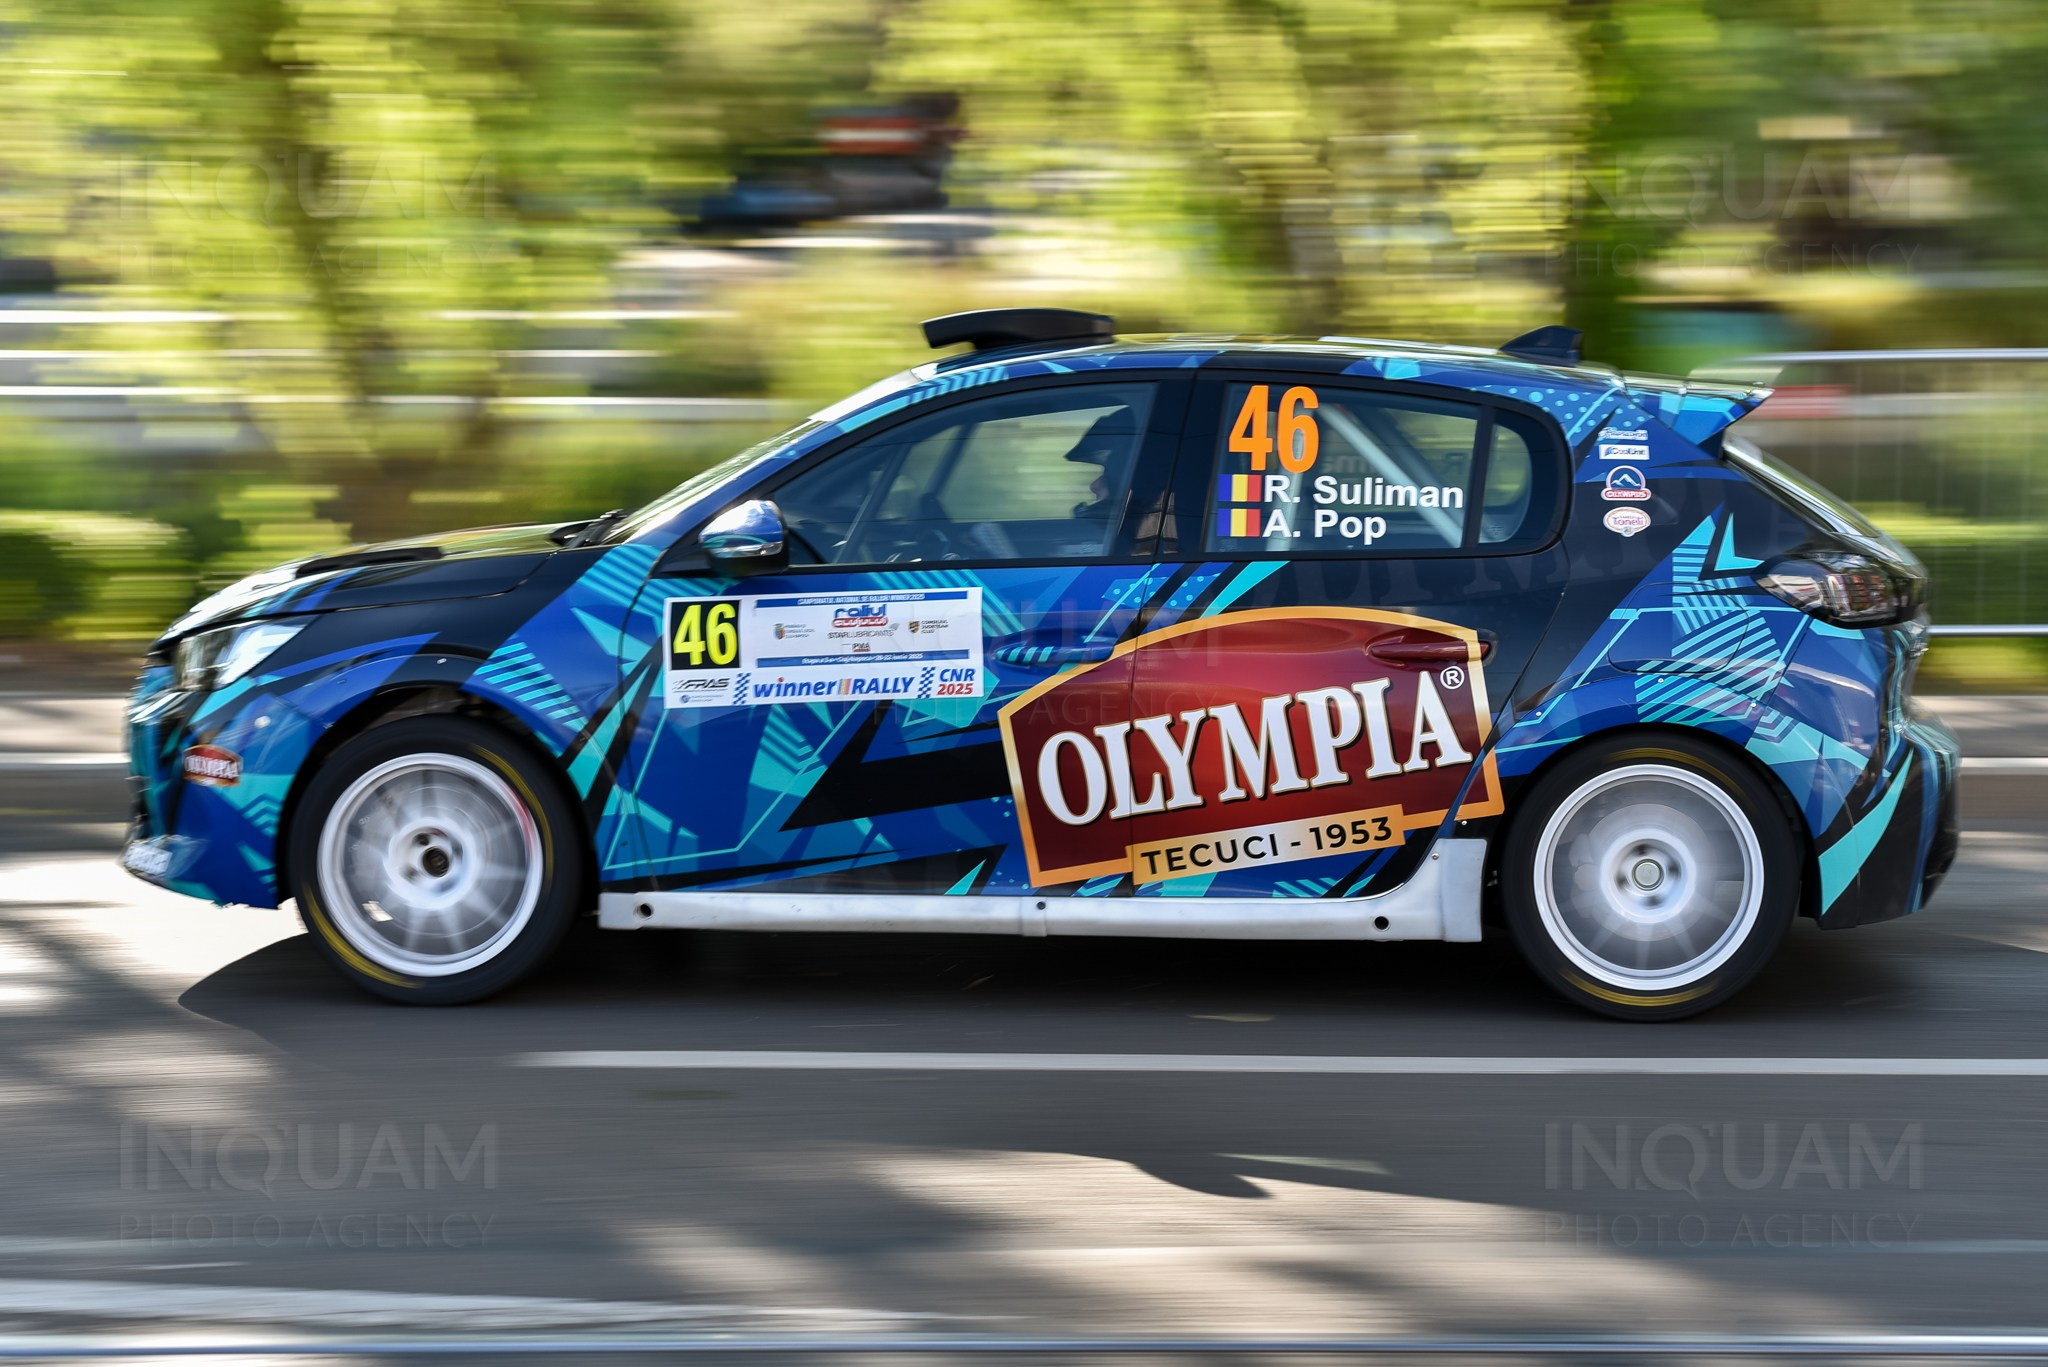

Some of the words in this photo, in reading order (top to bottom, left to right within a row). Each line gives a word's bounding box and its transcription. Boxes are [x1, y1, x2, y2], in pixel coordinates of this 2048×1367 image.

[1228, 385, 1319, 473] 46
[1264, 475, 1300, 504] R.
[1313, 475, 1464, 508] Suliman
[1262, 510, 1300, 537] A.
[1314, 510, 1386, 545] Pop
[673, 603, 738, 666] 46
[754, 677, 838, 698] winner
[851, 677, 915, 695] RALLY
[937, 683, 973, 695] 2025
[940, 668, 976, 682] CNR
[1141, 833, 1278, 877] TECUCI
[1310, 816, 1392, 851] 1953
